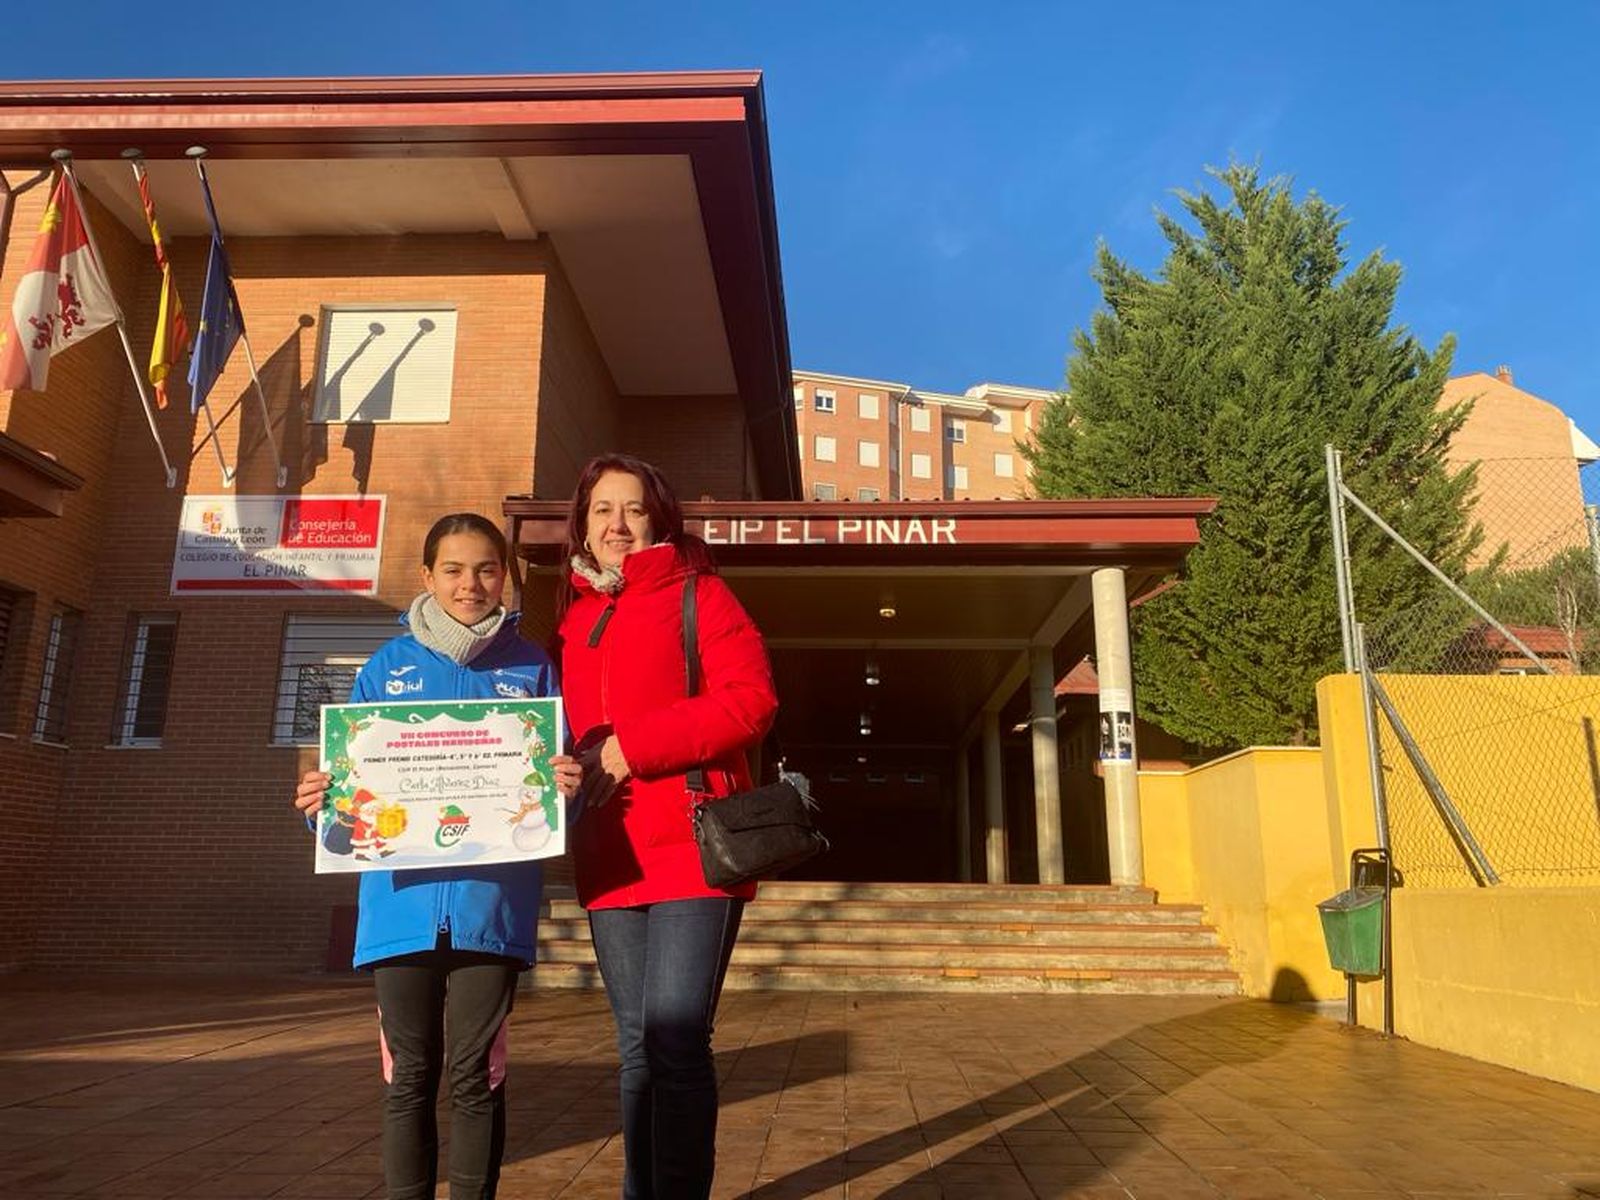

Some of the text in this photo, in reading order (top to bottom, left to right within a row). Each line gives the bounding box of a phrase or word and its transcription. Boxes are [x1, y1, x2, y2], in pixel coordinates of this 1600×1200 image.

[223, 526, 268, 535] Junta de
[290, 519, 357, 533] Consejería
[776, 519, 826, 545] EL
[838, 519, 957, 545] PINAR
[194, 534, 266, 545] Castilla y León
[288, 531, 372, 544] de Educación
[180, 552, 218, 562] COLEGIO
[220, 552, 233, 562] DE
[327, 551, 333, 561] Y
[335, 551, 375, 561] PRIMARIA
[243, 563, 307, 577] EL PINAR
[416, 730, 474, 739] CONCURSO
[476, 729, 489, 737] DE
[386, 739, 440, 748] POSTALES
[442, 824, 471, 837] CSIF
